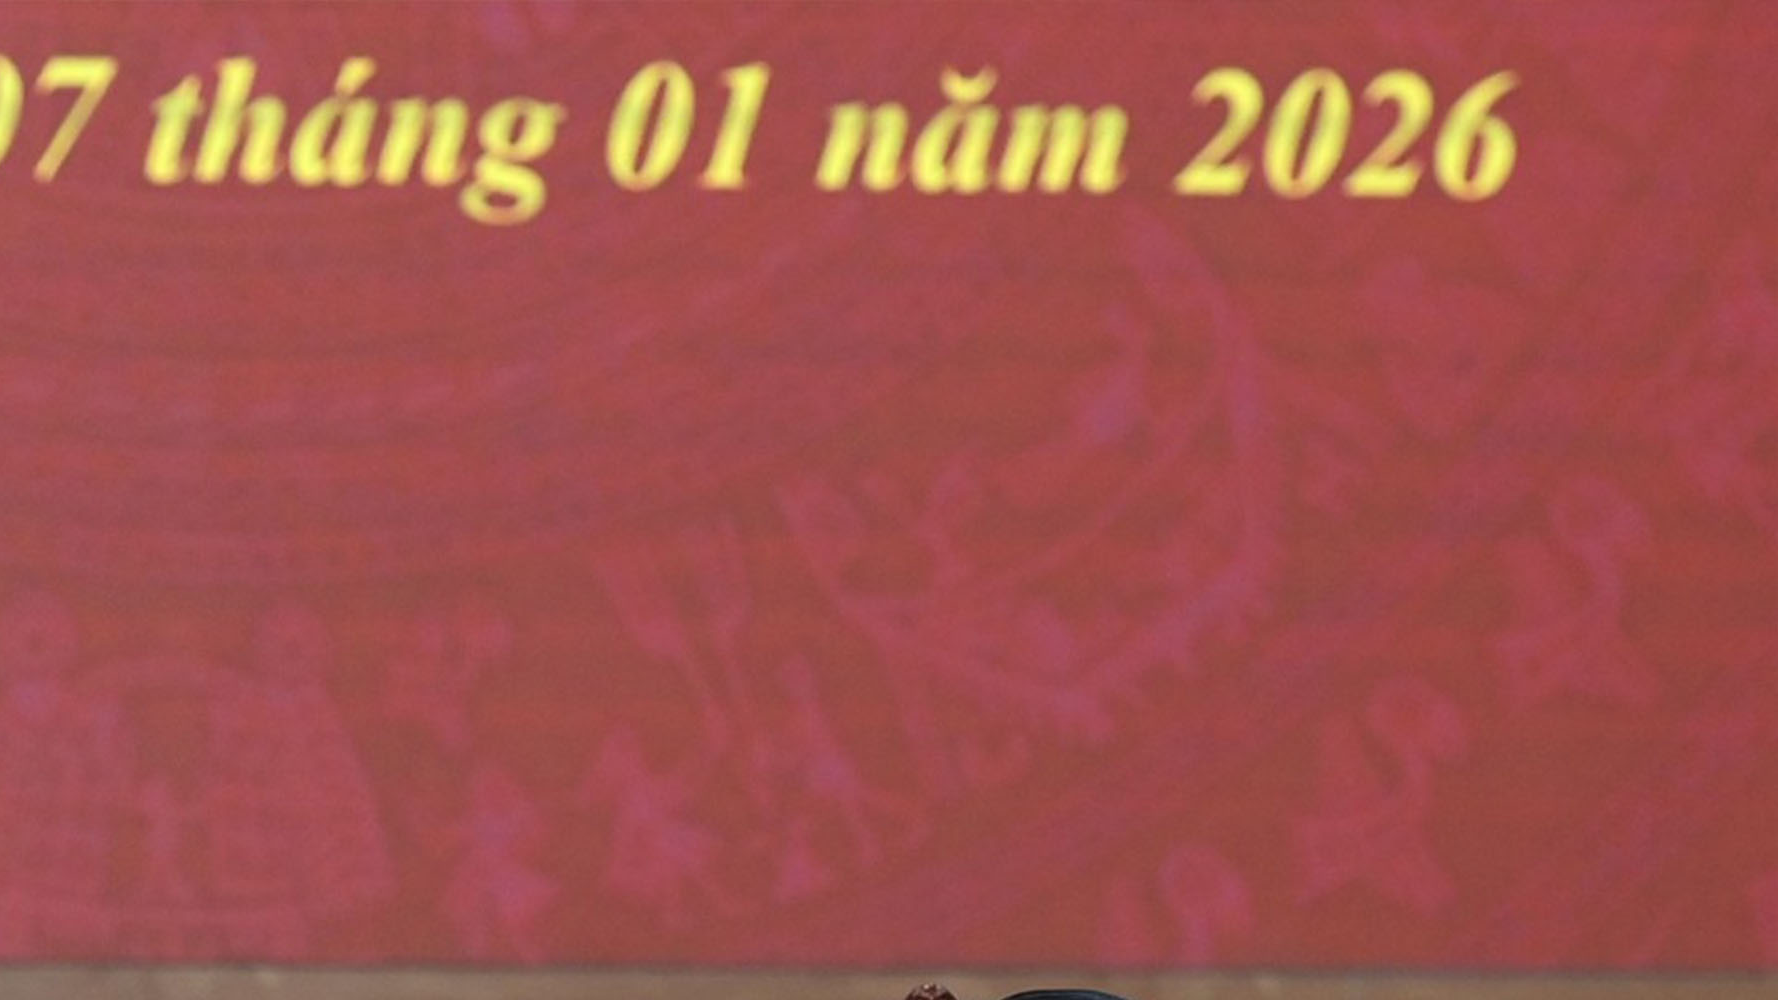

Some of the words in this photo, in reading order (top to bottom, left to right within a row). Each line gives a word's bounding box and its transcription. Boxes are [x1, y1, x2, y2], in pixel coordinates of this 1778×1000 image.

[144, 55, 565, 224] tháng
[605, 62, 771, 191] 01
[815, 66, 1129, 195] năm
[1173, 67, 1519, 200] 2026
